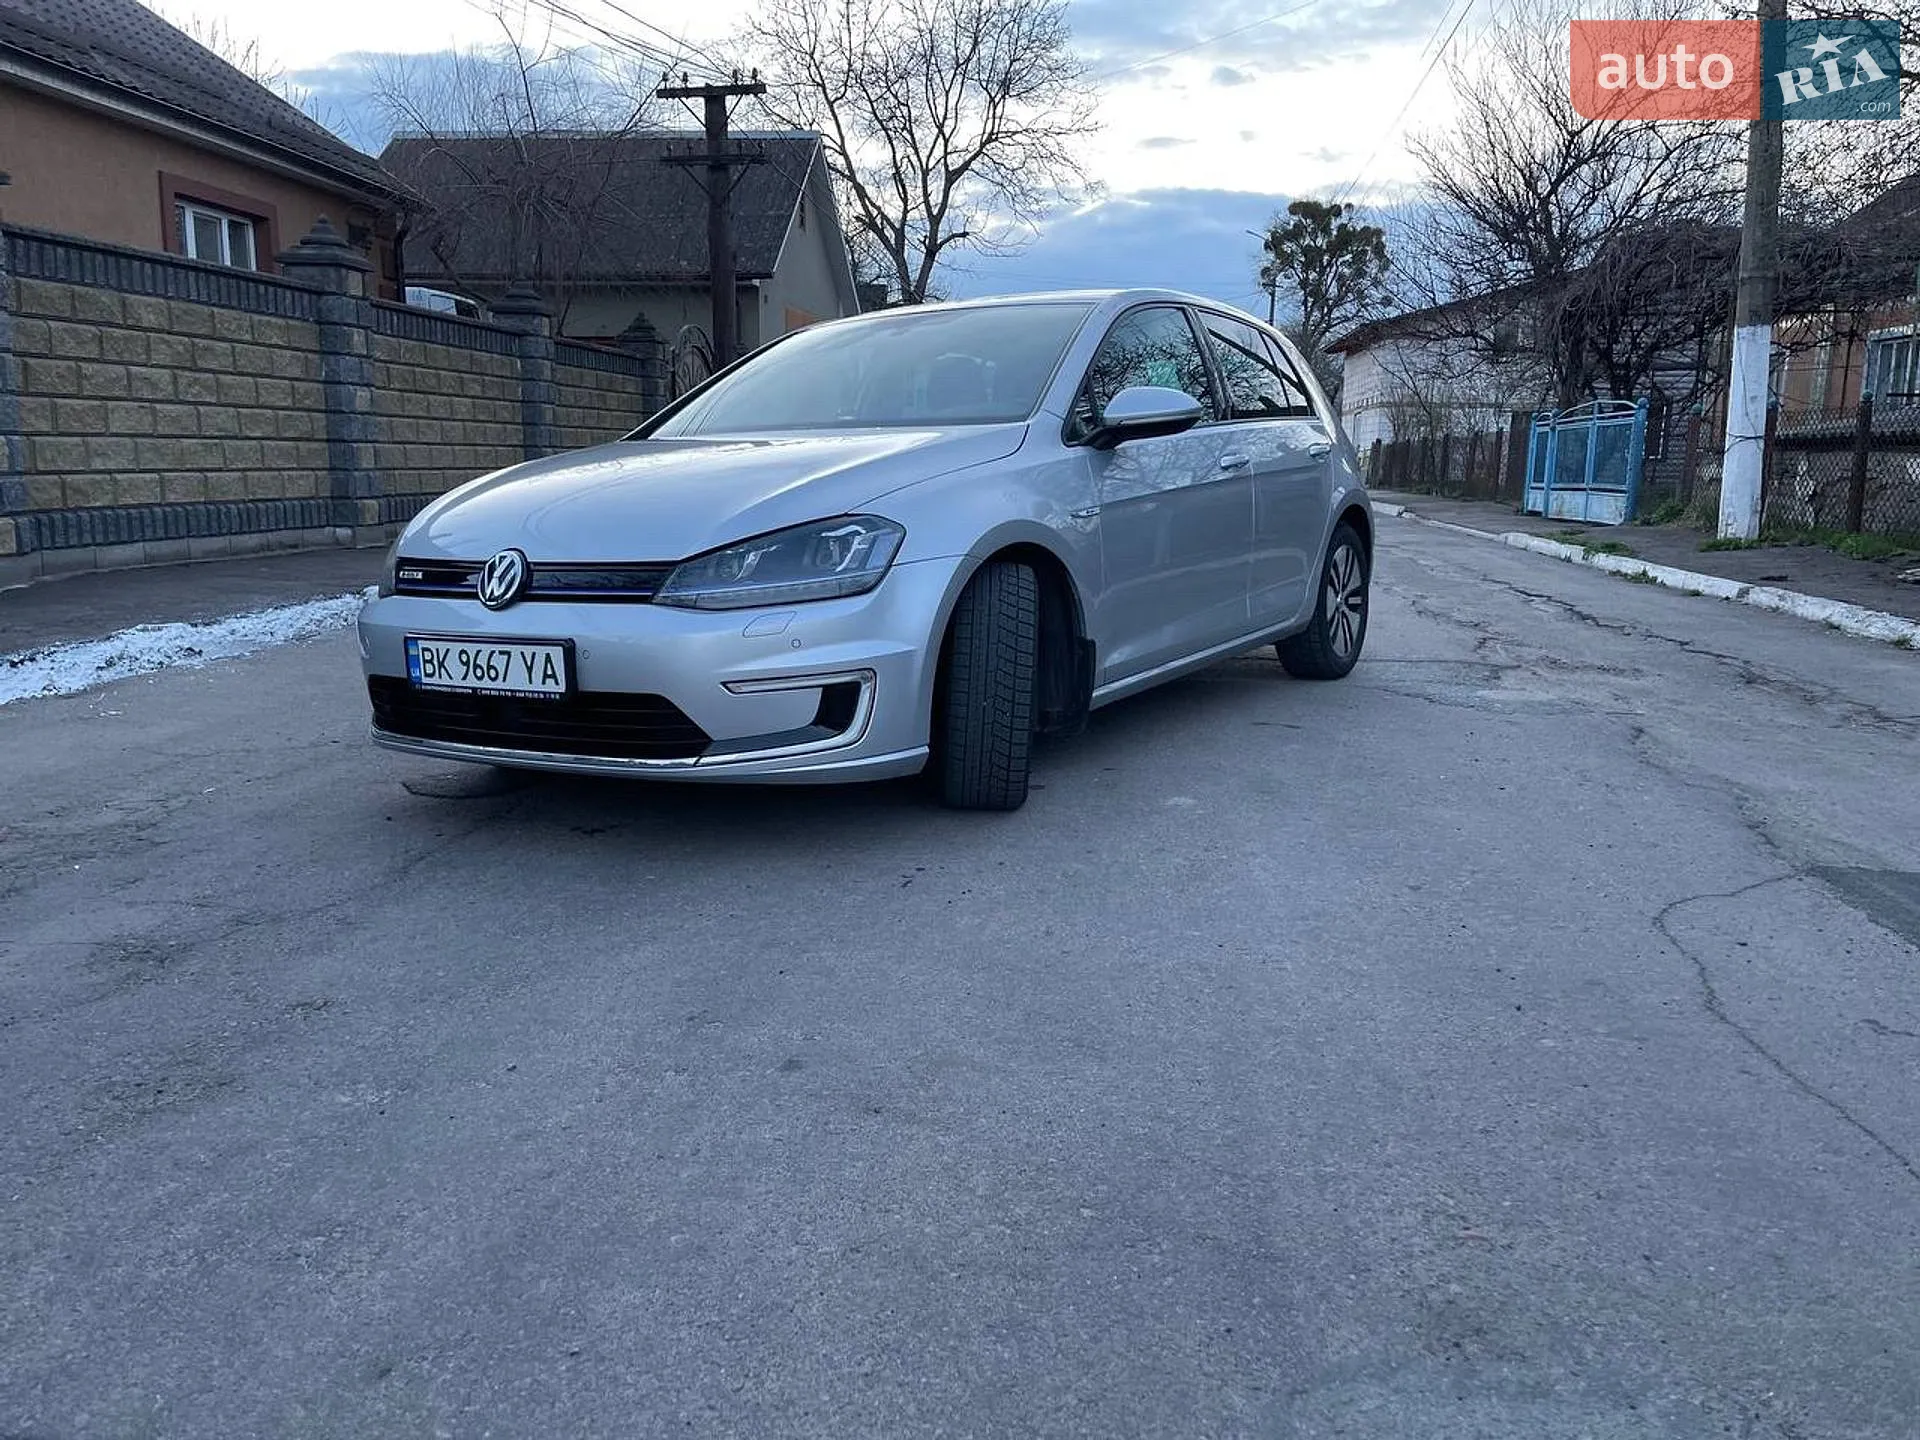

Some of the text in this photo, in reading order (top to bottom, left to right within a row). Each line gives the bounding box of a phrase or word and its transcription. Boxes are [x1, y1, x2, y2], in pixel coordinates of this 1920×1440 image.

[421, 646, 560, 686] BK 9667 YA
